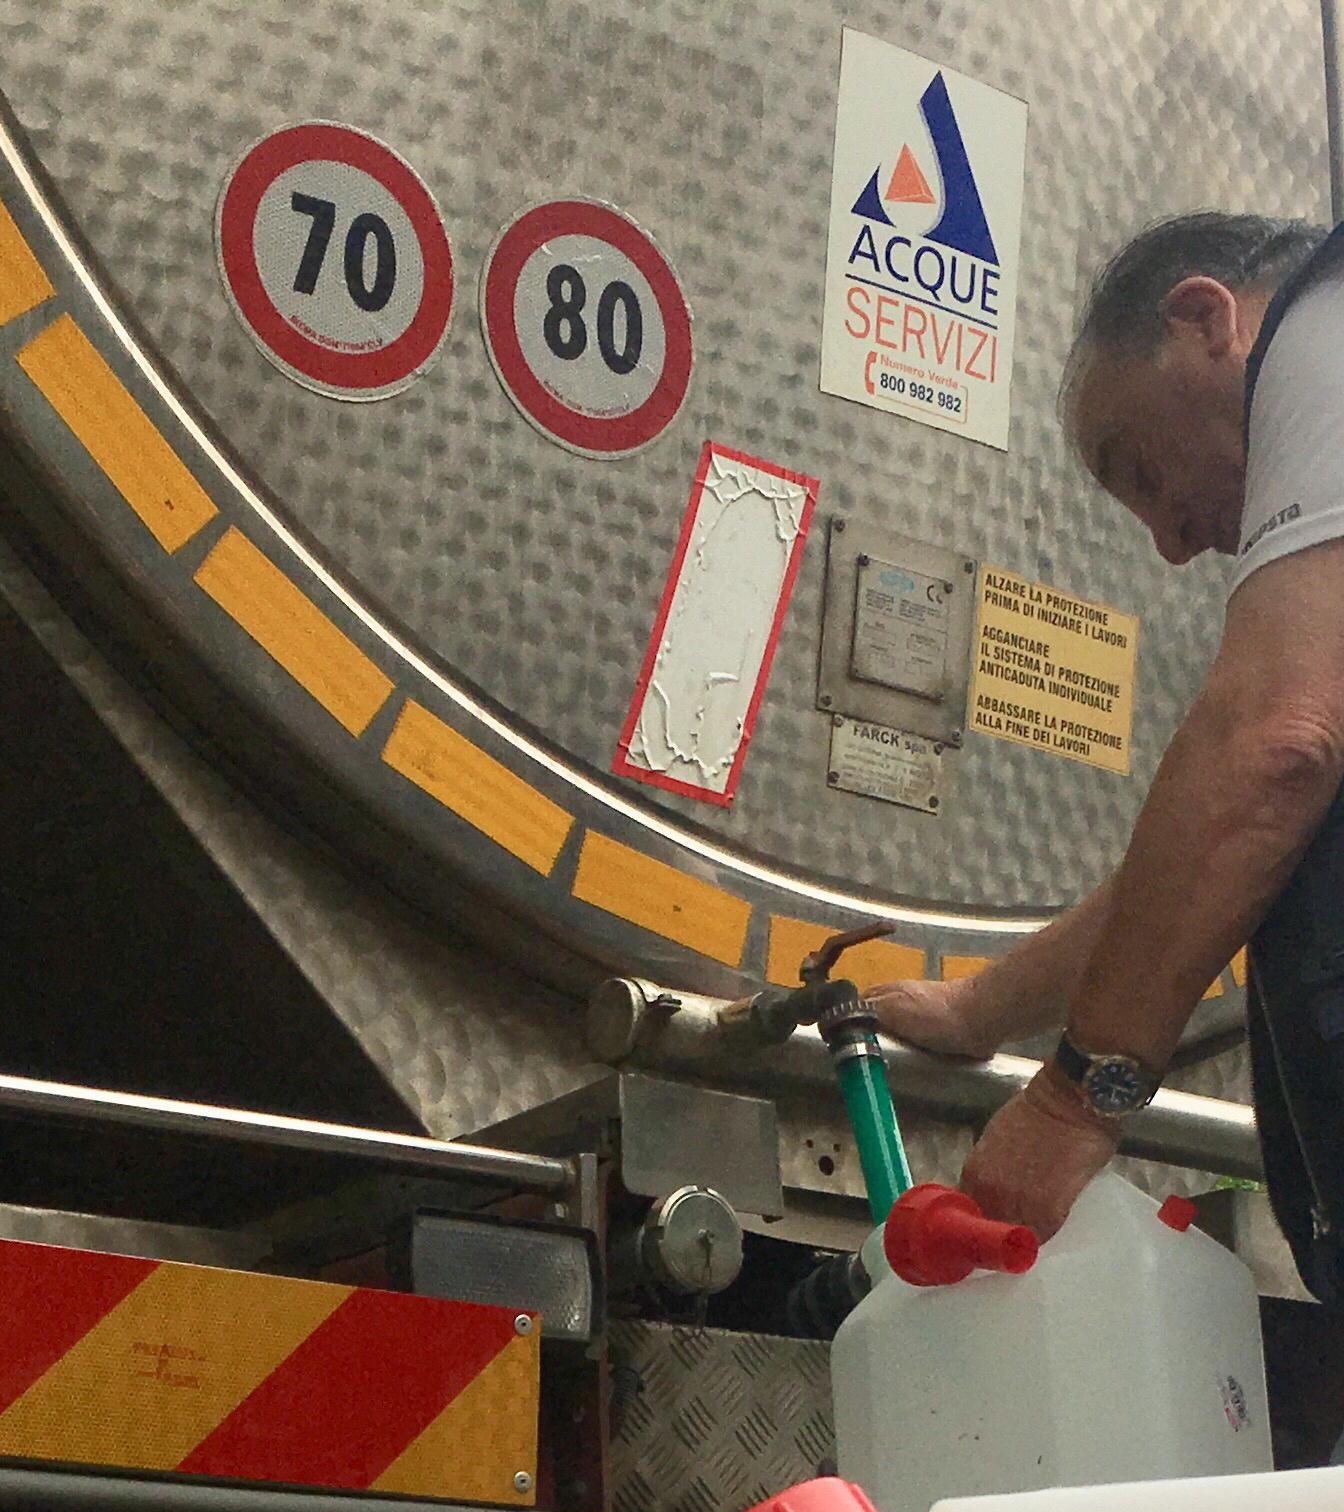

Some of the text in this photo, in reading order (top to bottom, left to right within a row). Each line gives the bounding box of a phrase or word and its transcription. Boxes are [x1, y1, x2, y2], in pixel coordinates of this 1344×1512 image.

[291, 192, 396, 312] 70
[848, 225, 1001, 315] ACQUE
[544, 264, 643, 375] 80
[845, 287, 997, 383] SERVIZI
[880, 354, 959, 390] Numero Verde
[880, 372, 962, 413] 800 982 982
[985, 574, 1108, 626] ALZARE LA PROTEZIONE
[985, 590, 1019, 614] PRIMA
[1023, 601, 1034, 617] DI
[1037, 606, 1082, 634] INIZIARE
[1092, 625, 1127, 648] LAVORI
[982, 624, 1049, 658] AGGANCIARE
[979, 659, 1112, 713] ANTICADUTA INDIVIDUALE
[981, 642, 1120, 698] IL SISTEMA DI PROTEZIONE
[975, 711, 1090, 756] ALLA FINE DEI LAVORI
[977, 694, 1122, 750] ABBASSARE LA PROTEZIONE
